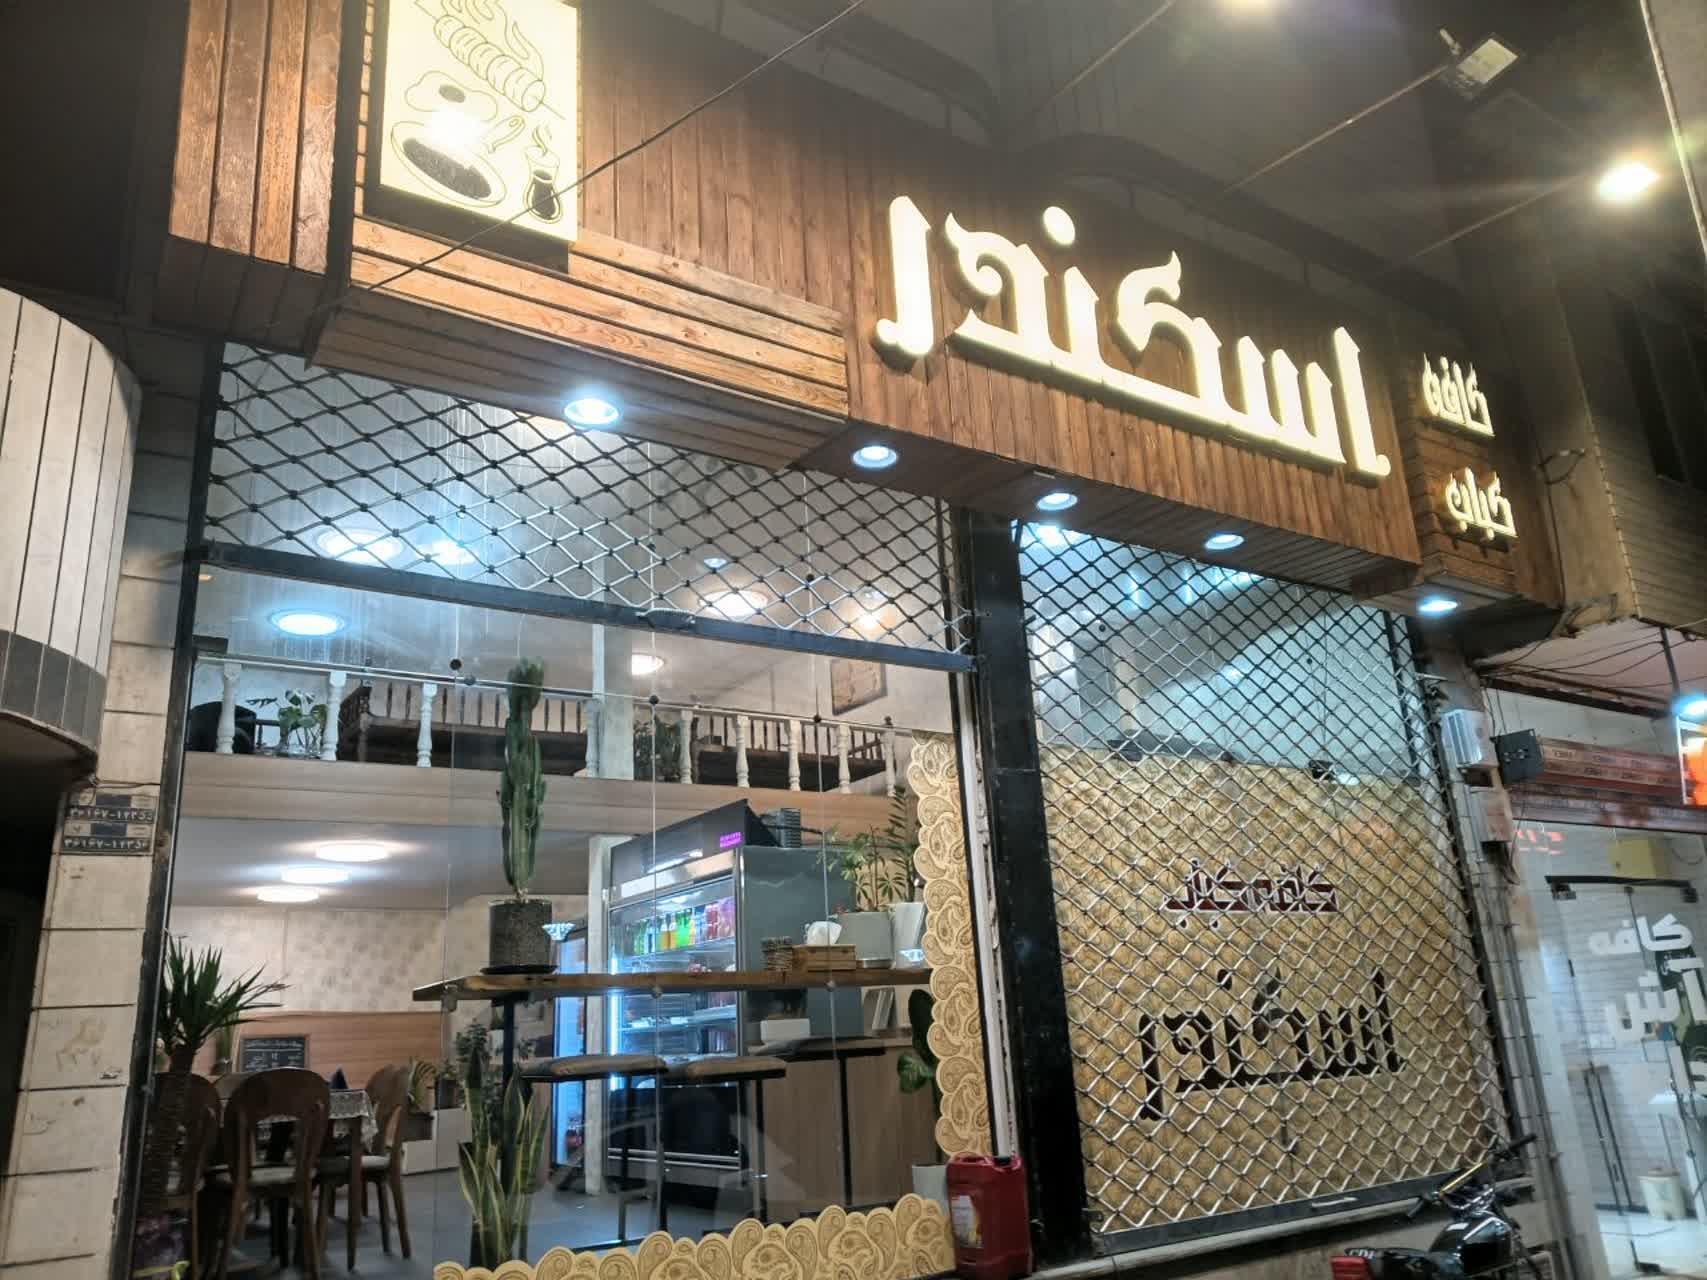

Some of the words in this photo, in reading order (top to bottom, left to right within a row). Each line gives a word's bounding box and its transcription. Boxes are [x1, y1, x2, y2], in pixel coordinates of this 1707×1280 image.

[876, 195, 1391, 477] اسکندر
[1422, 353, 1495, 437] کافه
[1445, 466, 1519, 541] کباب
[1162, 858, 1250, 929] کباب
[1250, 863, 1339, 913] کافه
[1589, 913, 1694, 956] کافه
[1138, 967, 1407, 1121] اسکندر
